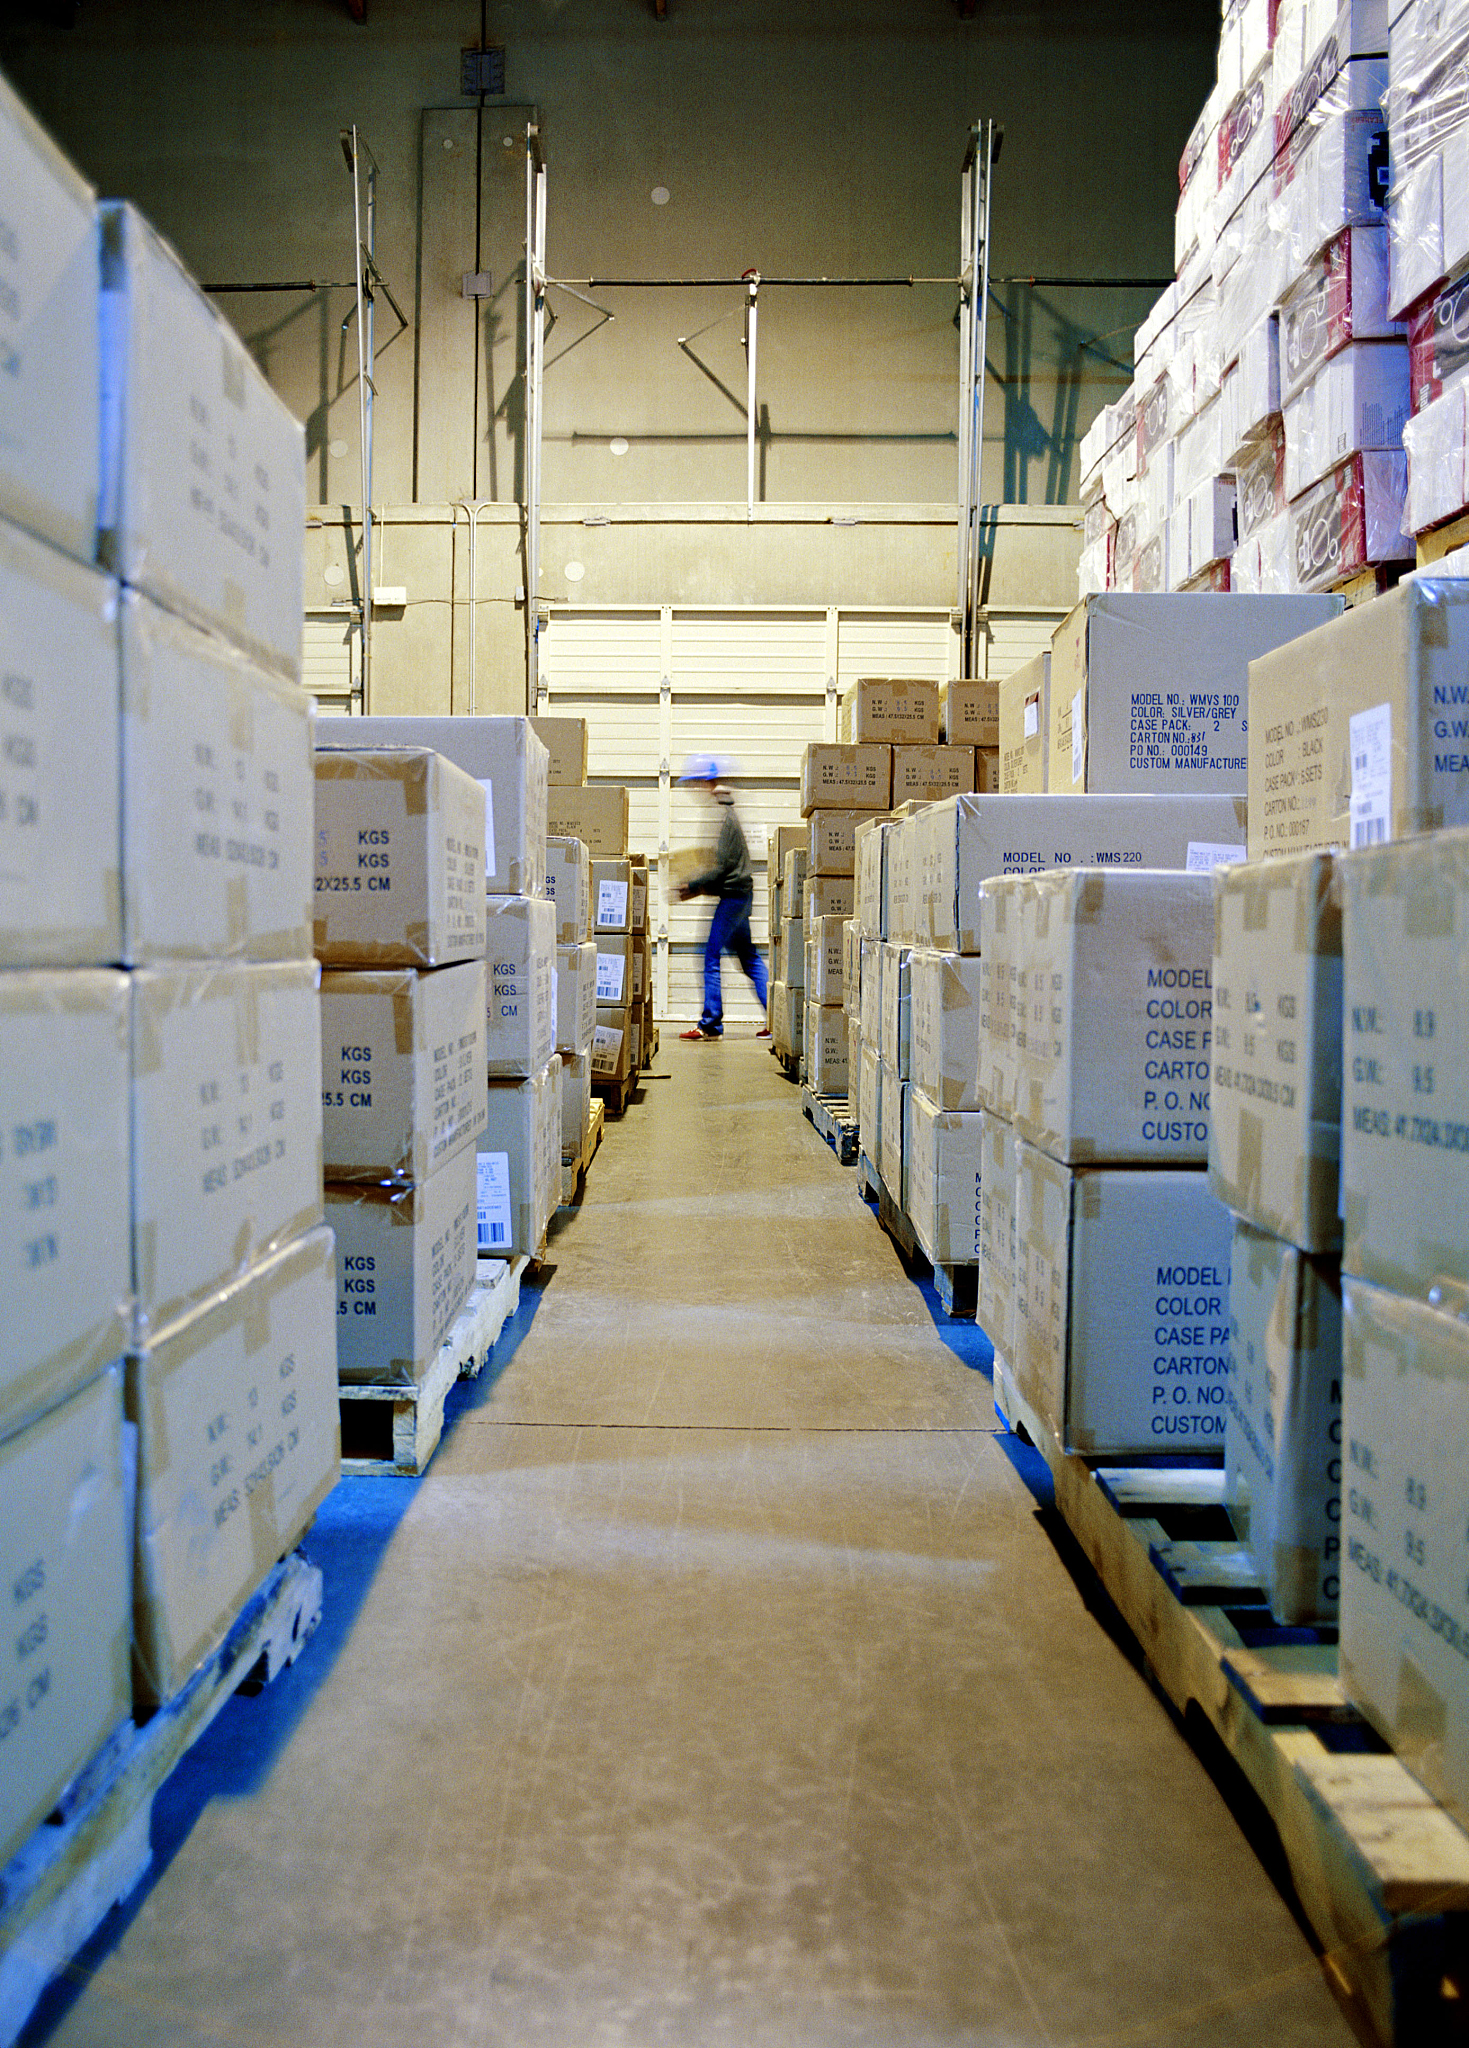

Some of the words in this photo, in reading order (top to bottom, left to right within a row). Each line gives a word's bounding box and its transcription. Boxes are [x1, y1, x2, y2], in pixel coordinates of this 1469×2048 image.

[1131, 693, 1163, 705] MODEL
[1190, 694, 1220, 706] WMVS
[1223, 694, 1240, 707] 100
[1131, 706, 1165, 718] COLOR:
[1171, 707, 1237, 719] SILVER/GREY
[1130, 719, 1158, 731] CASE
[1162, 719, 1191, 731] PACK:
[1213, 720, 1220, 732] 2
[1130, 732, 1171, 743] CARTON
[1130, 744, 1144, 756] PO
[1171, 744, 1208, 757] 000149
[1264, 749, 1284, 769] COLOR
[1302, 737, 1324, 757] BLACK
[1129, 757, 1170, 769] CUSTOM
[1174, 757, 1247, 770] MANUFACTURE
[357, 830, 390, 846] KGS
[357, 853, 390, 869] KGS
[1003, 852, 1046, 863] MODEL
[367, 876, 391, 892] CM
[493, 963, 516, 976] KGS
[1147, 968, 1213, 989] MODEL
[494, 984, 517, 996] KGS
[501, 1005, 518, 1017] CM
[1146, 1000, 1212, 1019] COLOR
[1145, 1030, 1196, 1050] CASE
[340, 1046, 372, 1062] KGS
[340, 1069, 372, 1085] KGS
[1144, 1061, 1210, 1080] CARTO
[350, 1092, 372, 1108] CM
[1141, 1121, 1208, 1141] CUSTO
[343, 1256, 376, 1271] KGS
[1156, 1266, 1222, 1286] MODEL
[343, 1279, 376, 1294] KGS
[353, 1301, 377, 1316] CM
[1155, 1297, 1221, 1316] COLOR
[1154, 1327, 1205, 1346] CASE
[1153, 1357, 1229, 1375] CARTON
[1151, 1416, 1227, 1434] CUSTOM
